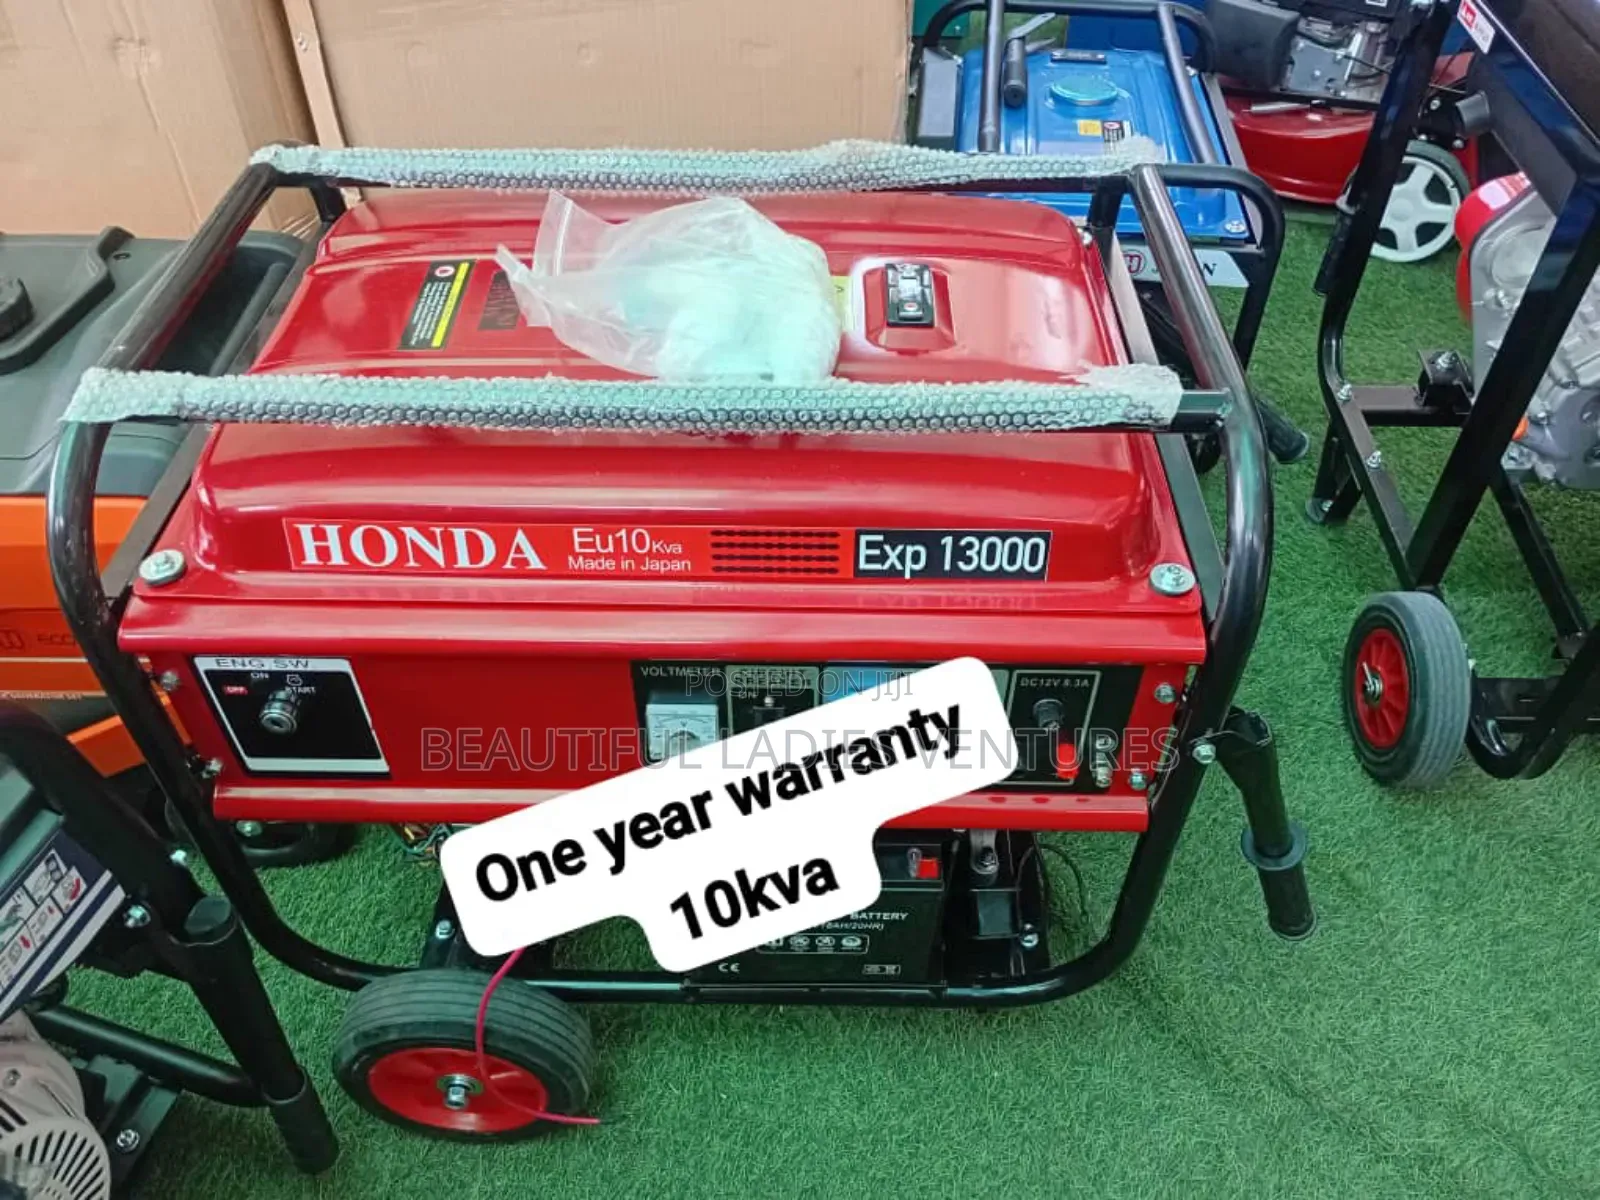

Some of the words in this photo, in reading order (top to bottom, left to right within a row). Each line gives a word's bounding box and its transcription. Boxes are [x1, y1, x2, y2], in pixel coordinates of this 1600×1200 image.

[294, 524, 546, 569] HONDA
[858, 534, 926, 579] Exp
[940, 535, 1045, 573] 13000
[568, 555, 615, 571] Made
[621, 555, 636, 571] in
[640, 557, 692, 575] Japan
[215, 658, 265, 669] ENG
[273, 658, 310, 669] SW
[640, 666, 721, 677] VOLTMETER
[850, 912, 908, 920] BATTERY
